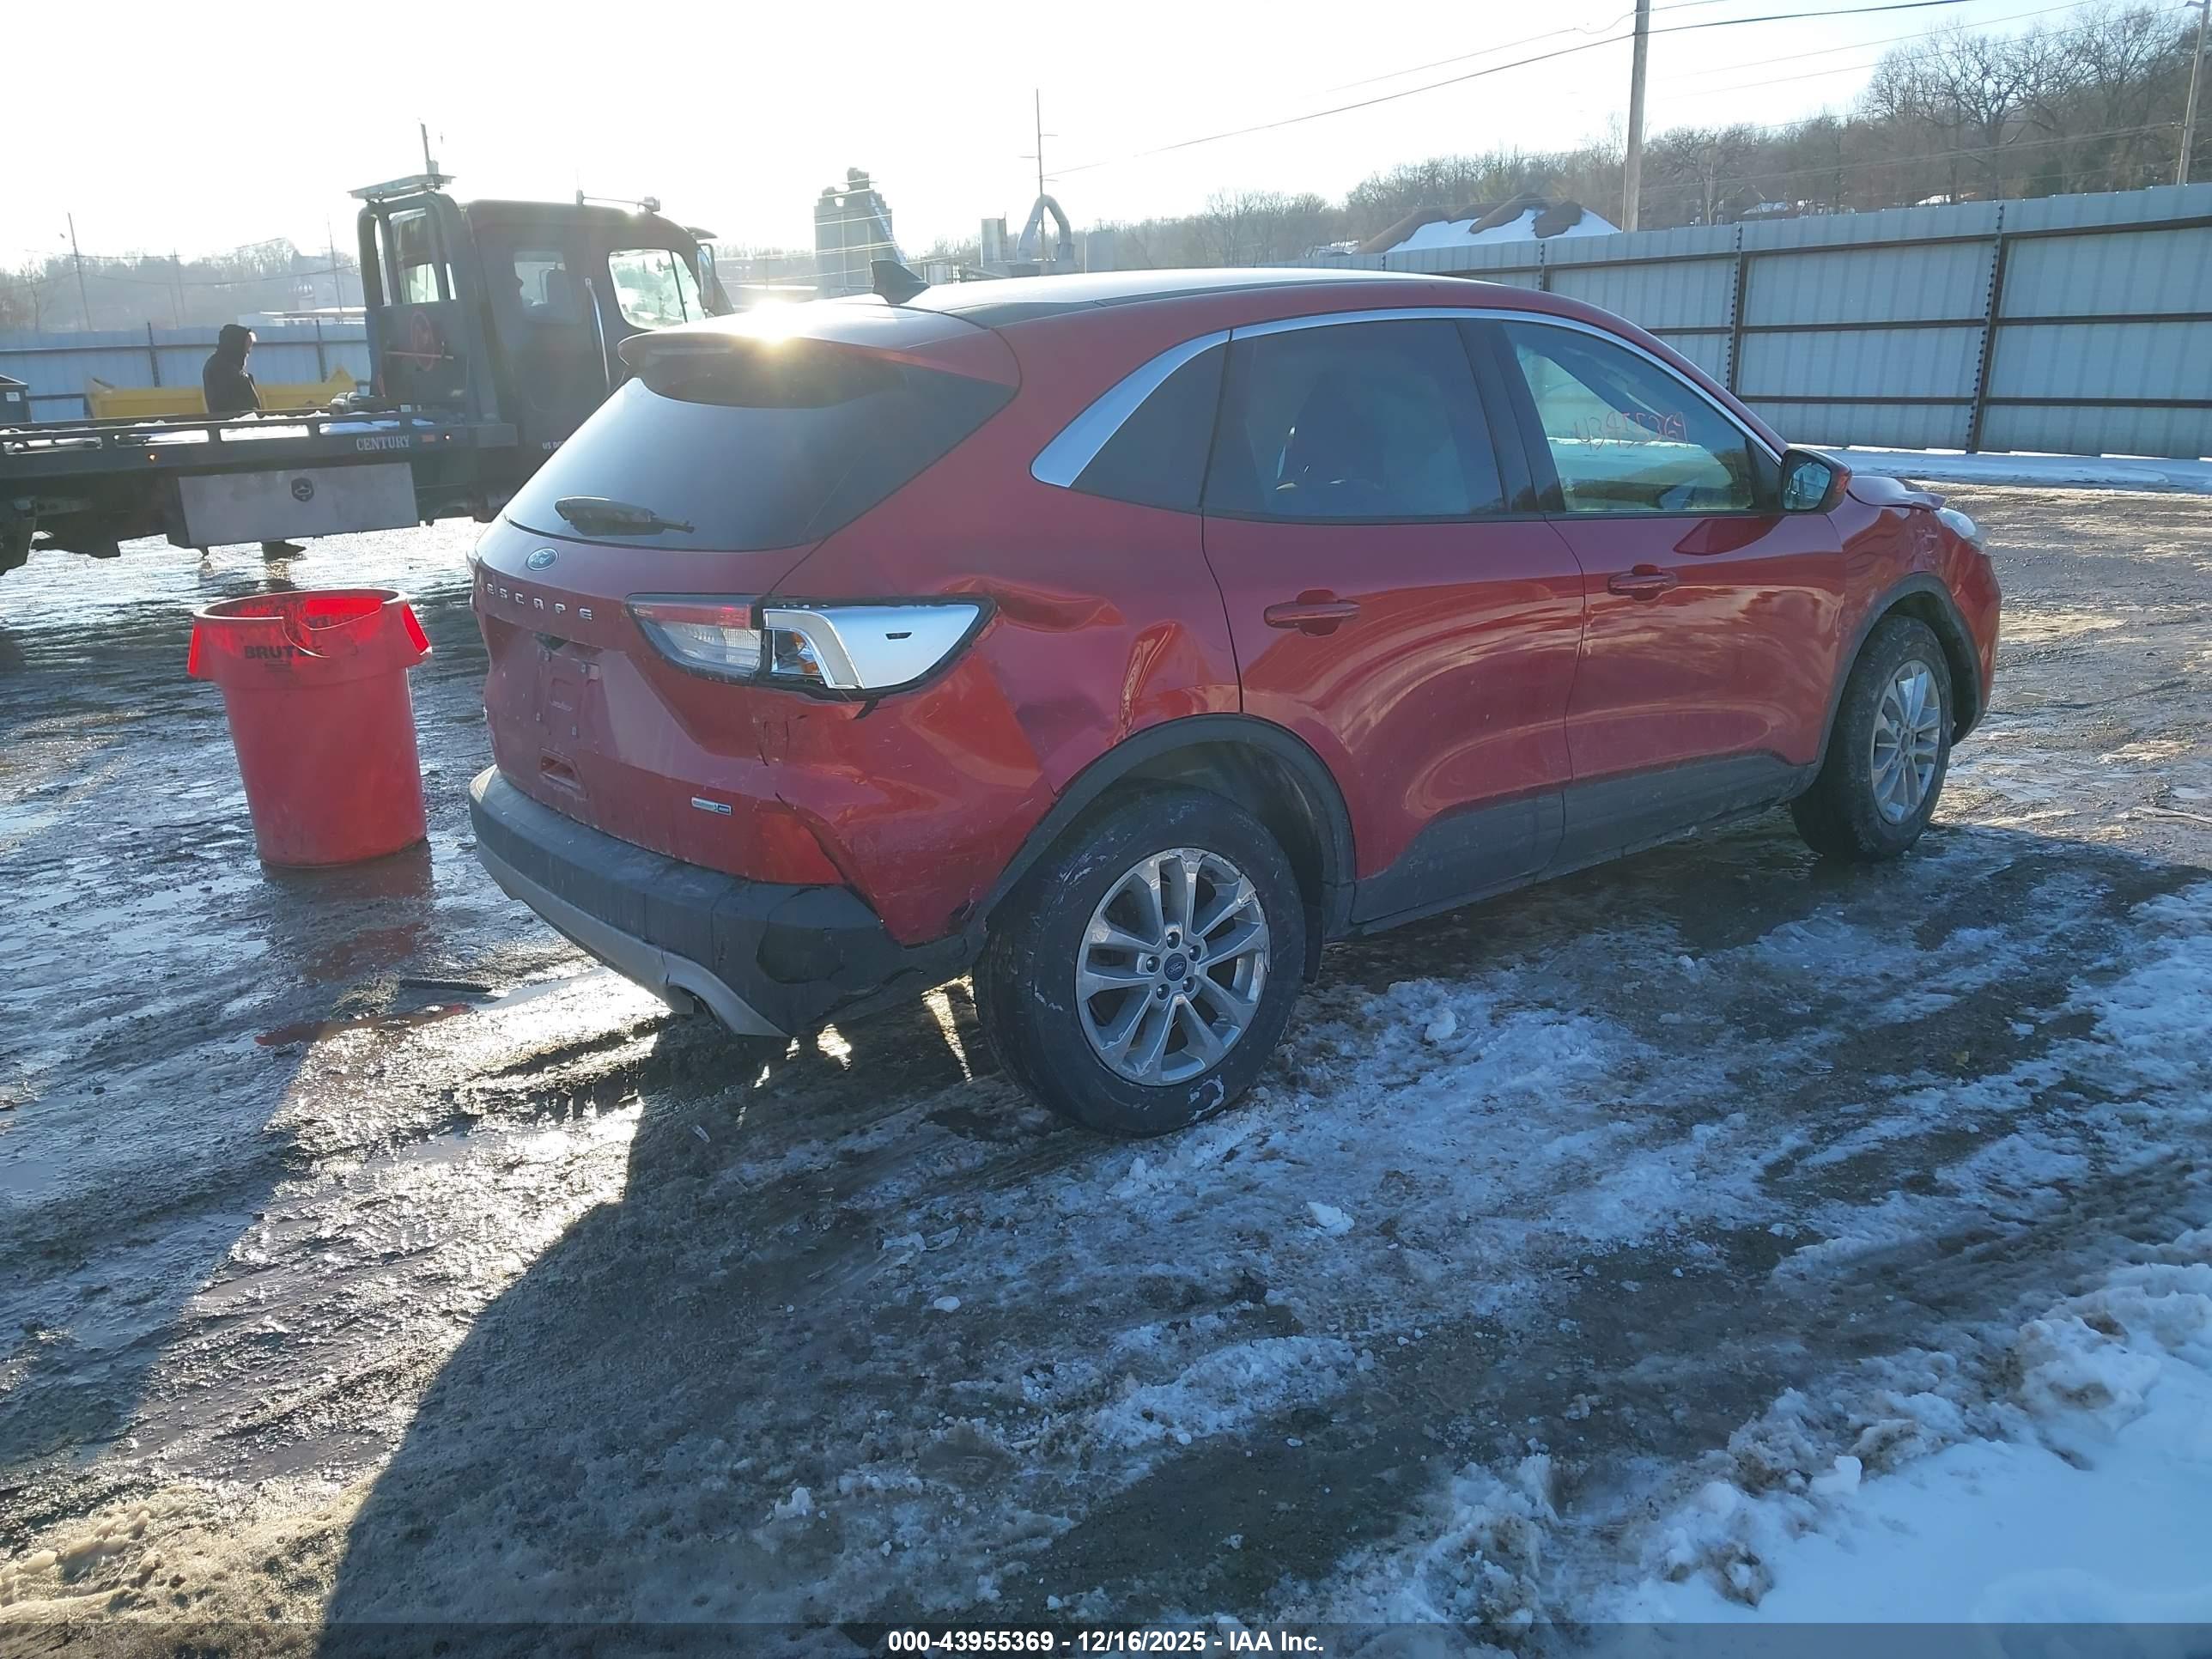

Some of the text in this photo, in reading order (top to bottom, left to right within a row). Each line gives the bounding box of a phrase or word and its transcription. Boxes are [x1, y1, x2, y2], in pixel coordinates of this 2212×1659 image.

[356, 434, 410, 452] CENTURY
[1572, 411, 1690, 451] 43955369
[486, 582, 593, 620] ESCAPE
